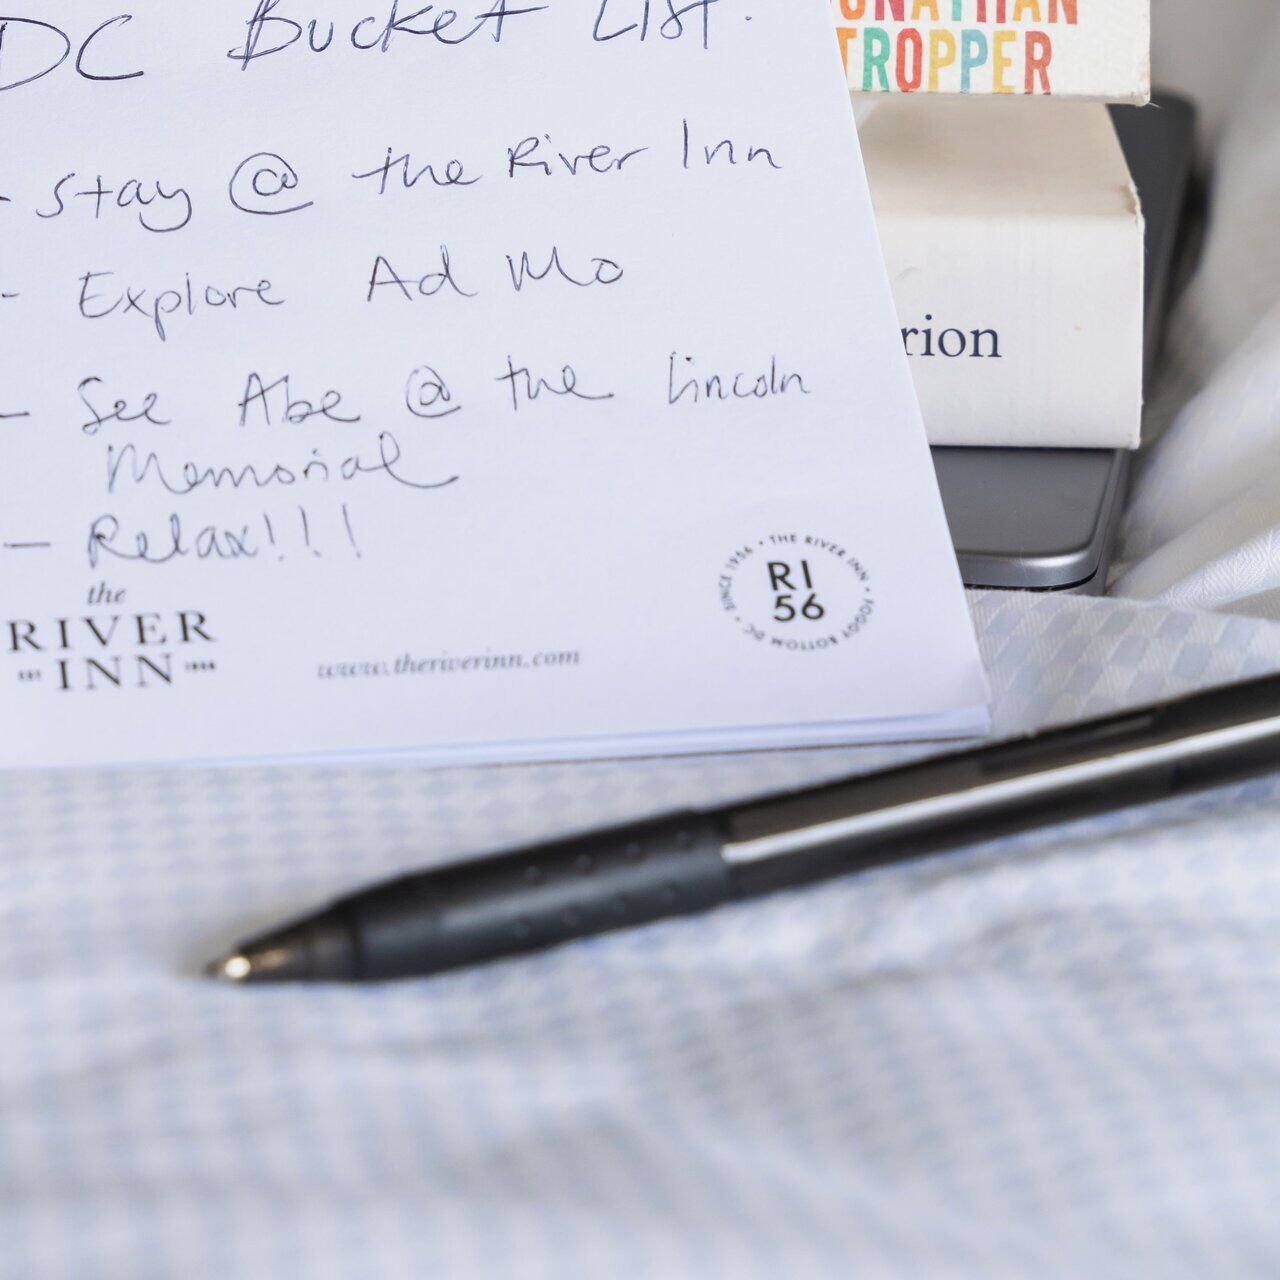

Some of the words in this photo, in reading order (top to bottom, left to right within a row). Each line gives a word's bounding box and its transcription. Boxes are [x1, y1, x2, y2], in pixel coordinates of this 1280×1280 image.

[229, 152, 314, 216] @
[352, 147, 481, 195] the
[508, 134, 648, 178] River
[683, 118, 782, 169] Inn
[78, 272, 285, 342] Explore
[367, 245, 477, 302] Ad
[506, 246, 623, 291] Mo
[77, 376, 170, 435] See
[238, 372, 361, 426] Abe
[406, 366, 462, 419] @
[495, 355, 615, 405] the
[108, 431, 459, 494] Memorial
[770, 534, 797, 544] THE
[805, 535, 846, 558] RIVER
[767, 559, 813, 592] RI
[847, 557, 869, 581] INN
[87, 581, 126, 606] the
[773, 590, 825, 623] 56
[6, 610, 216, 653] RIVER
[842, 598, 874, 639] FOGGY
[56, 652, 173, 692] INN
[318, 651, 579, 679] www.theriverinn.com
